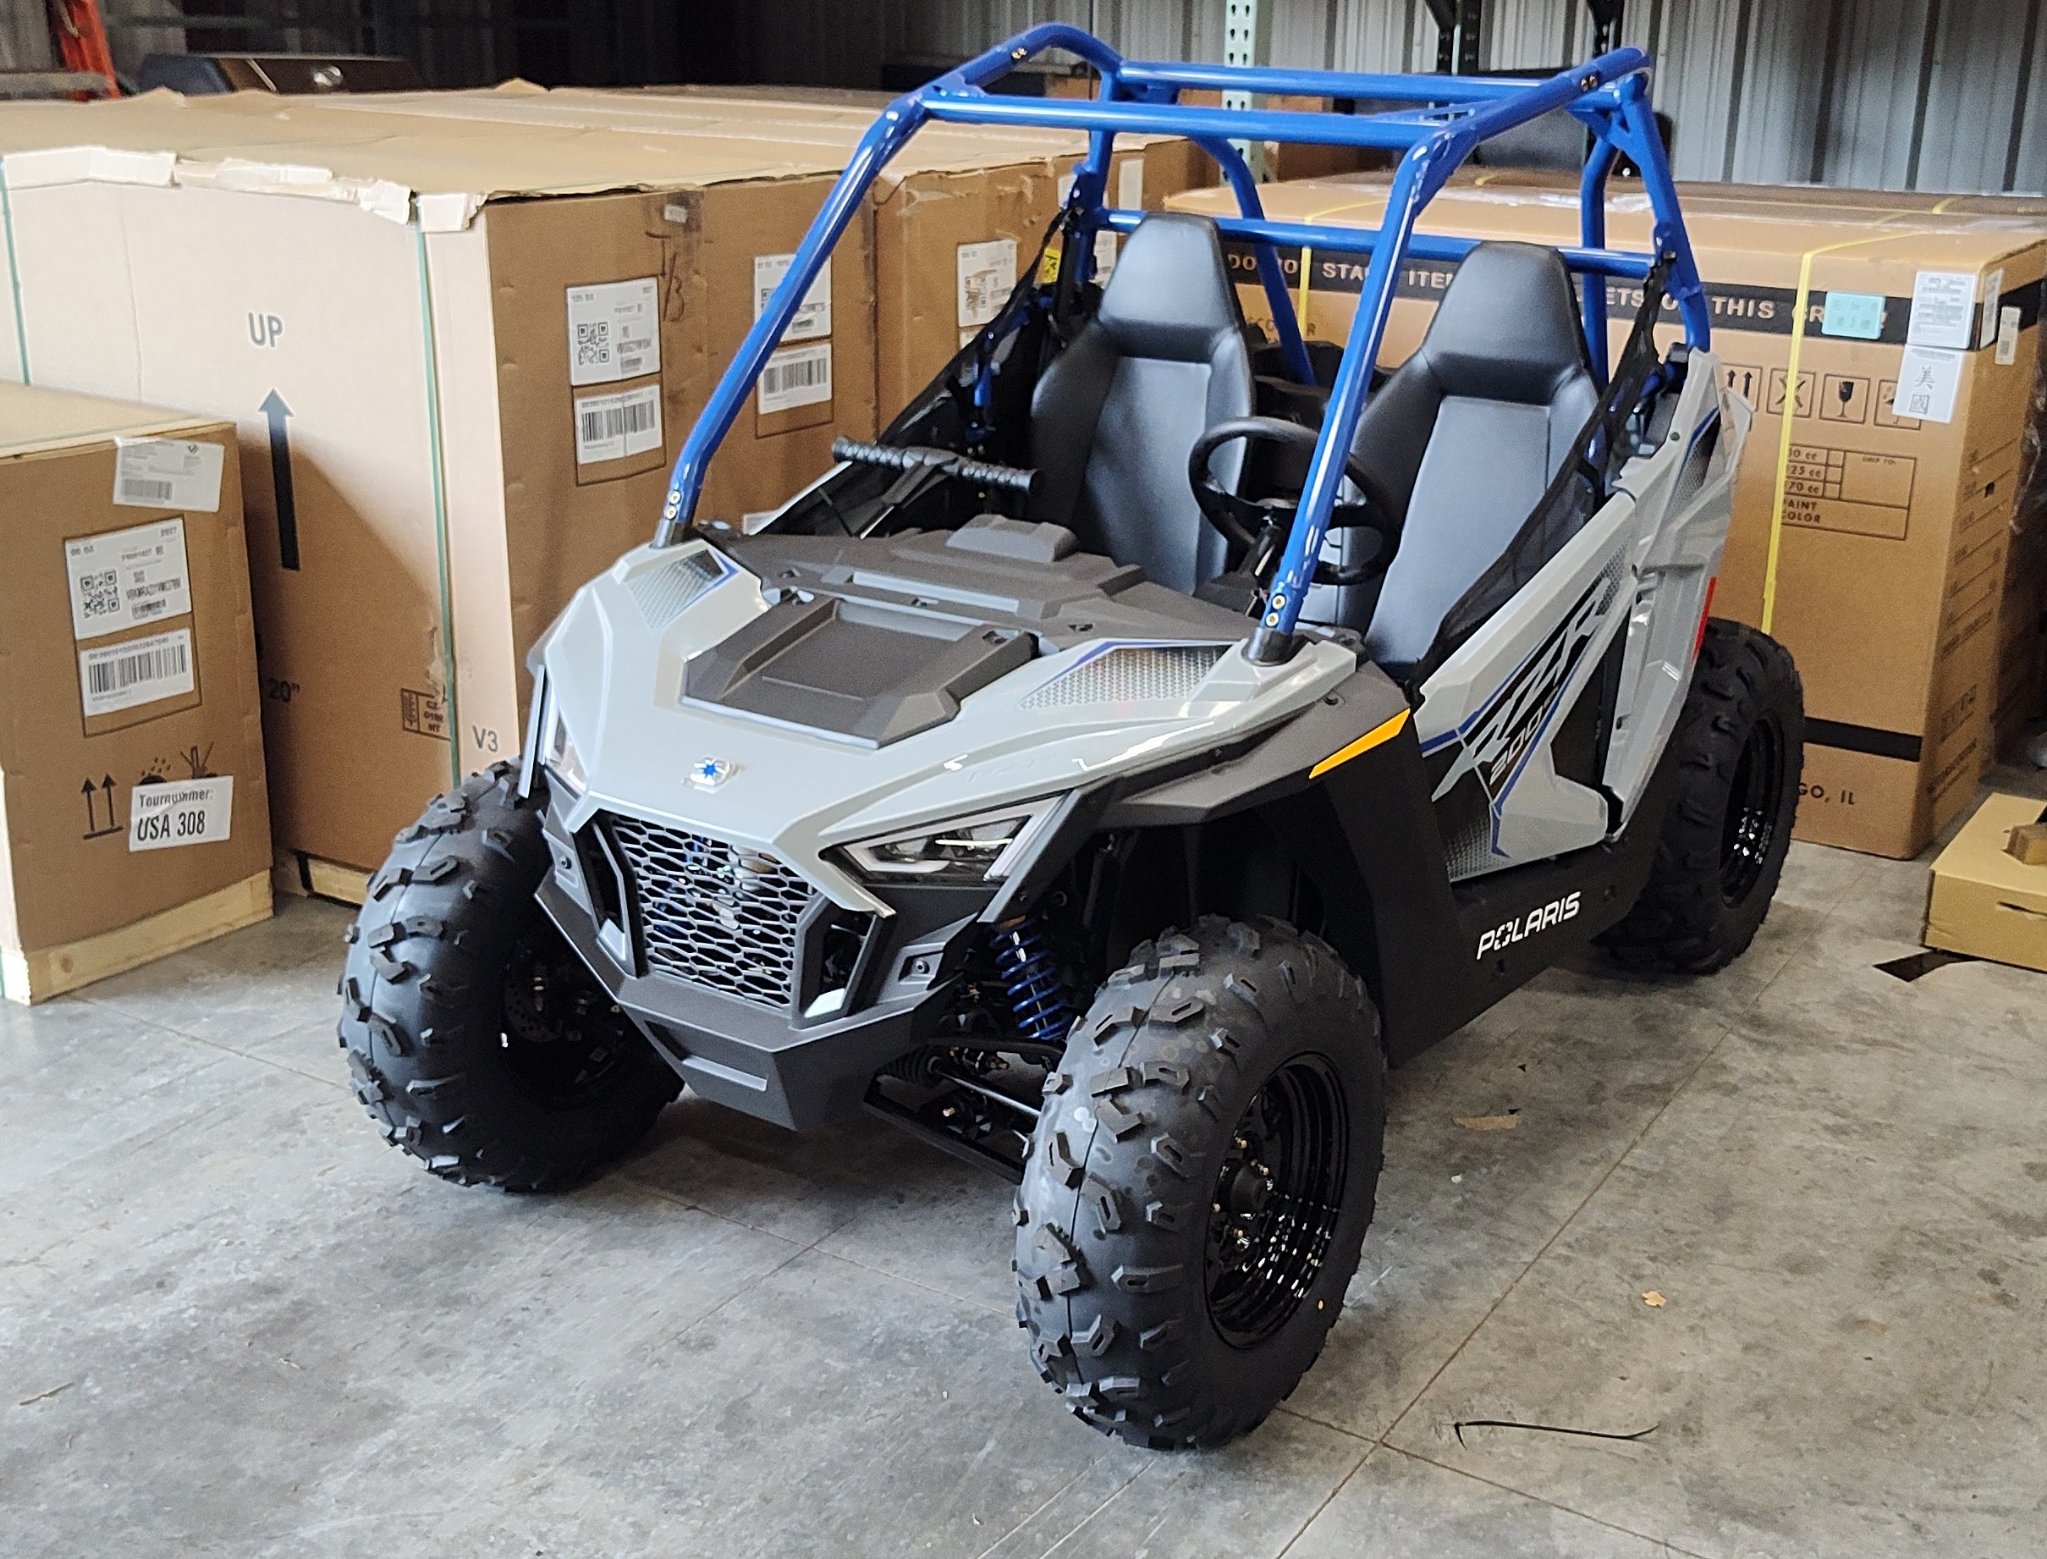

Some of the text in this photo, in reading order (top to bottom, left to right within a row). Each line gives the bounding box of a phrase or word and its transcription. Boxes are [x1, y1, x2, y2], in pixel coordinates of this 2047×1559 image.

[1322, 262, 1370, 281] STA
[1606, 286, 1645, 308] ETS
[1711, 296, 1775, 320] THIS
[248, 312, 283, 348] UP
[1784, 498, 1818, 511] AINT
[472, 724, 498, 752] V3
[1489, 705, 1544, 786] 200
[1840, 790, 1855, 806] IL
[137, 810, 205, 841] USA 308
[1476, 891, 1581, 961] POLARIS
